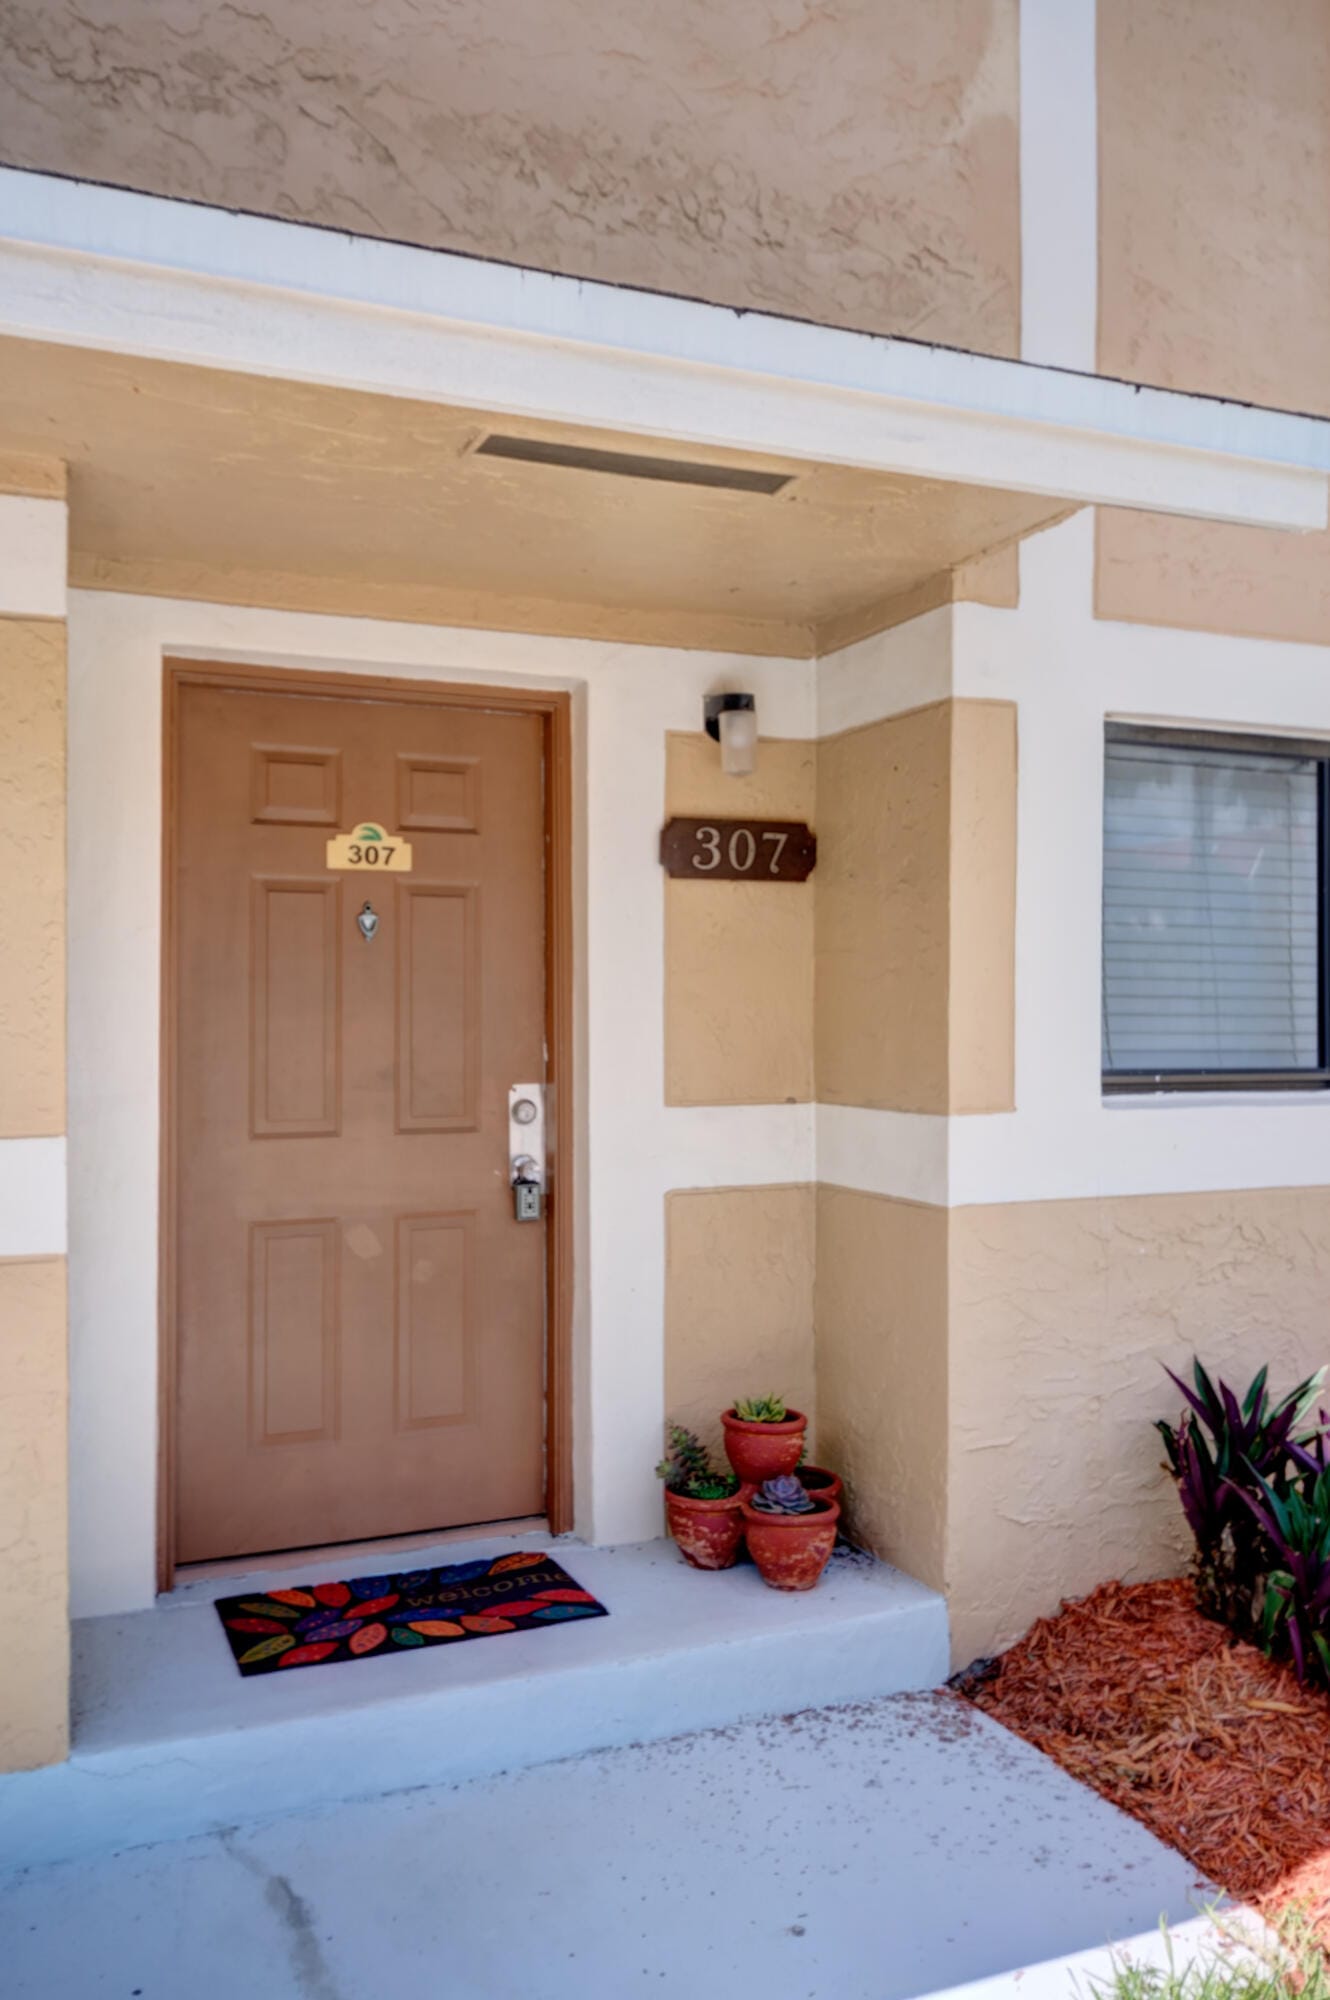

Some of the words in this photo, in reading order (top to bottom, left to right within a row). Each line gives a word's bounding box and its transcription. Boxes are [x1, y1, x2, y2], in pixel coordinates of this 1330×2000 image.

[347, 844, 396, 866] 307
[691, 826, 788, 874] 307
[407, 1572, 571, 1607] welcome
